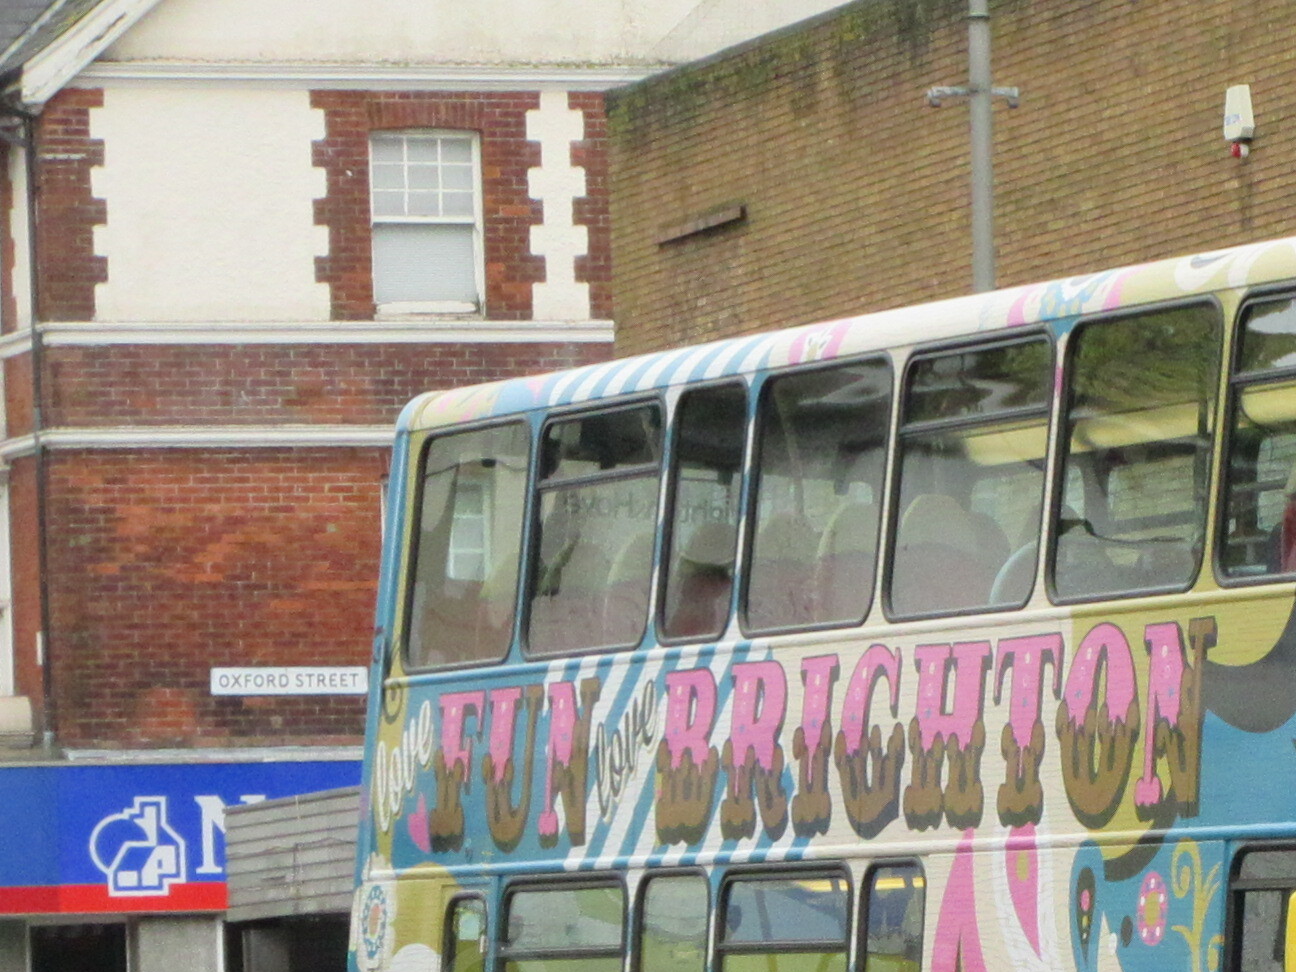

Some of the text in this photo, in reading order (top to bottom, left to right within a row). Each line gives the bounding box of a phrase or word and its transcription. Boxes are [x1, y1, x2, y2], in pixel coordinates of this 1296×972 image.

[218, 672, 360, 689] OXFORD STREET
[374, 616, 1218, 855] love FUN love BRIGHTON
